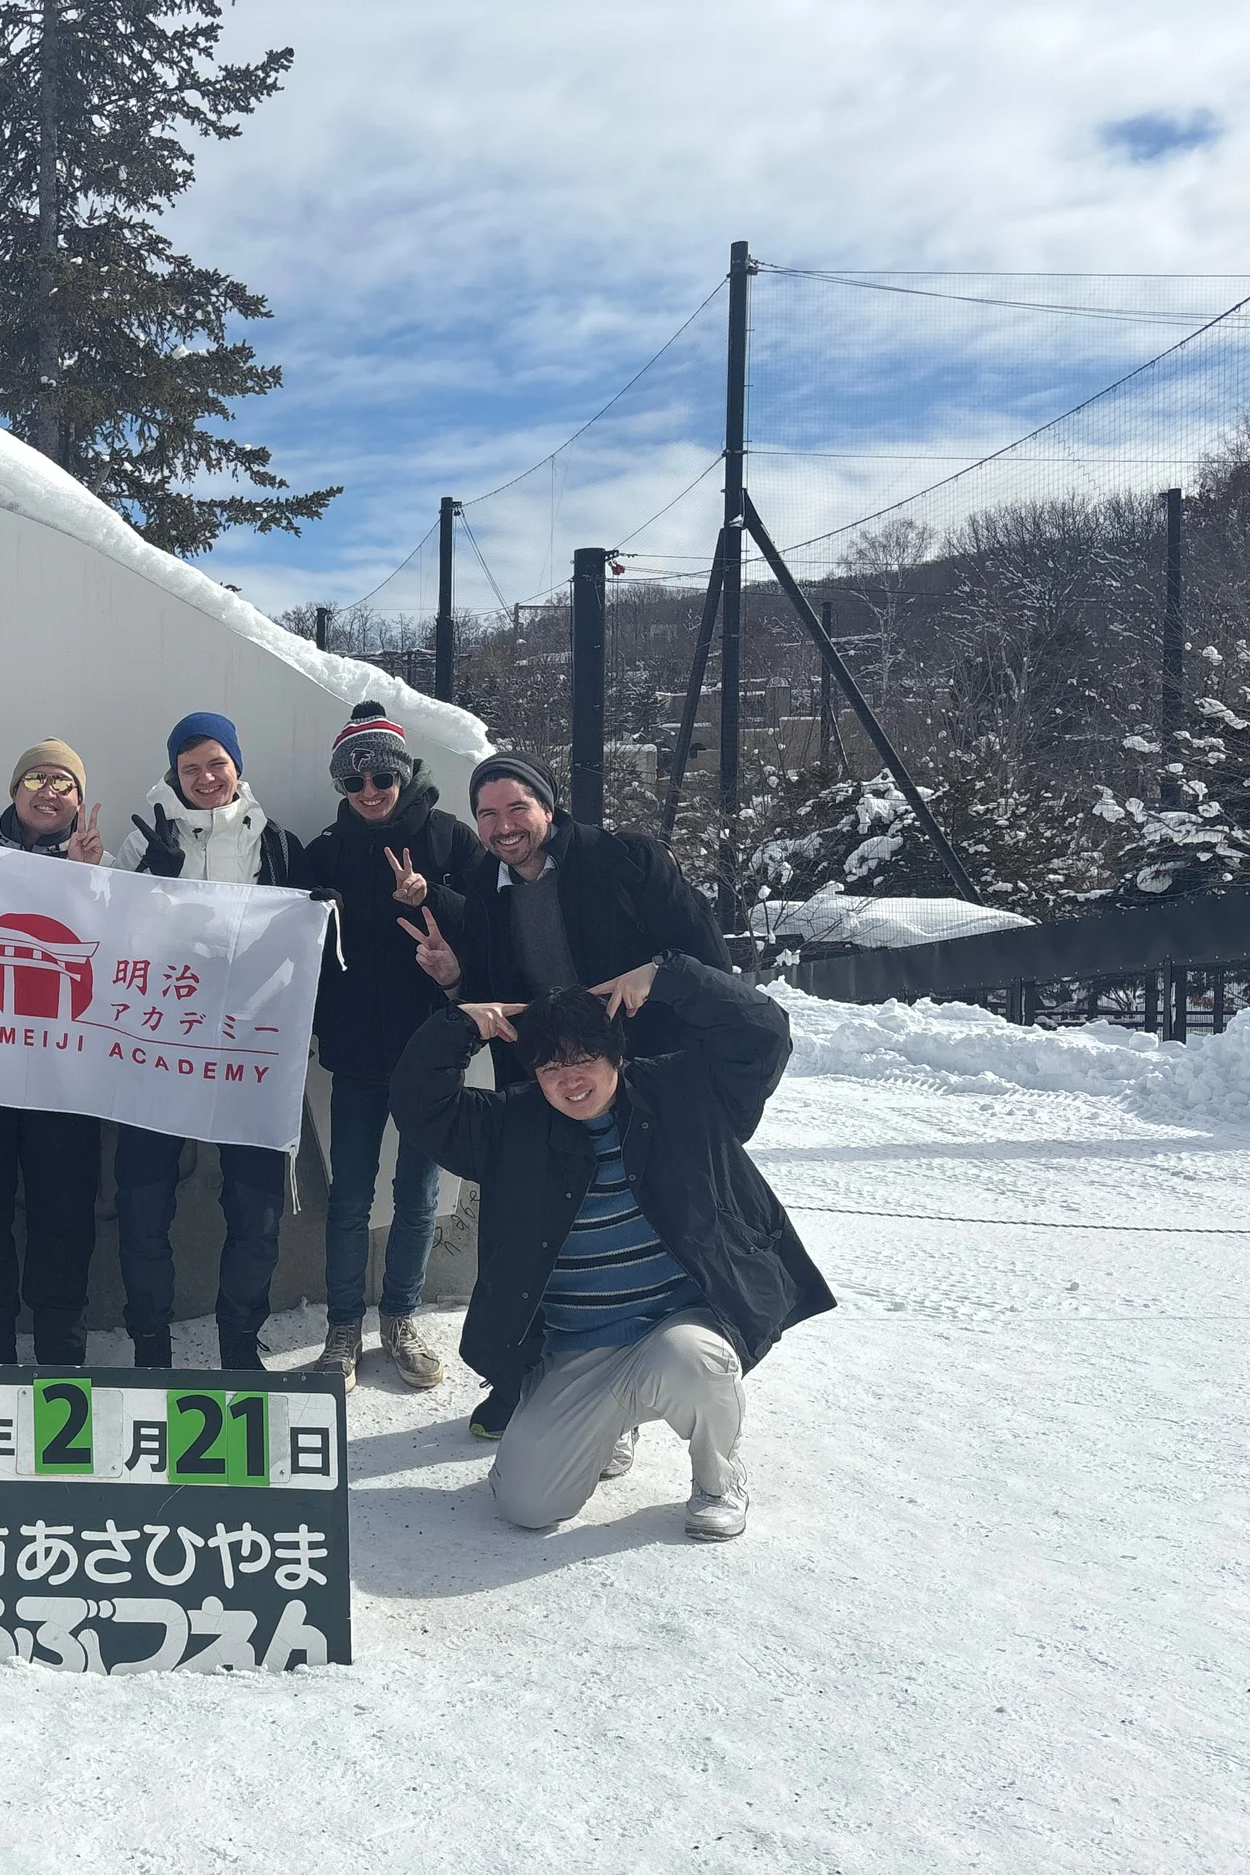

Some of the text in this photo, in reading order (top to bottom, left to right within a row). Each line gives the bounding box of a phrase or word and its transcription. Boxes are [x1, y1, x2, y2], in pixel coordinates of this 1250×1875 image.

[112, 959, 200, 1001] 明治
[110, 1002, 280, 1041] アカデミー
[108, 1042, 270, 1084] ACADEMY
